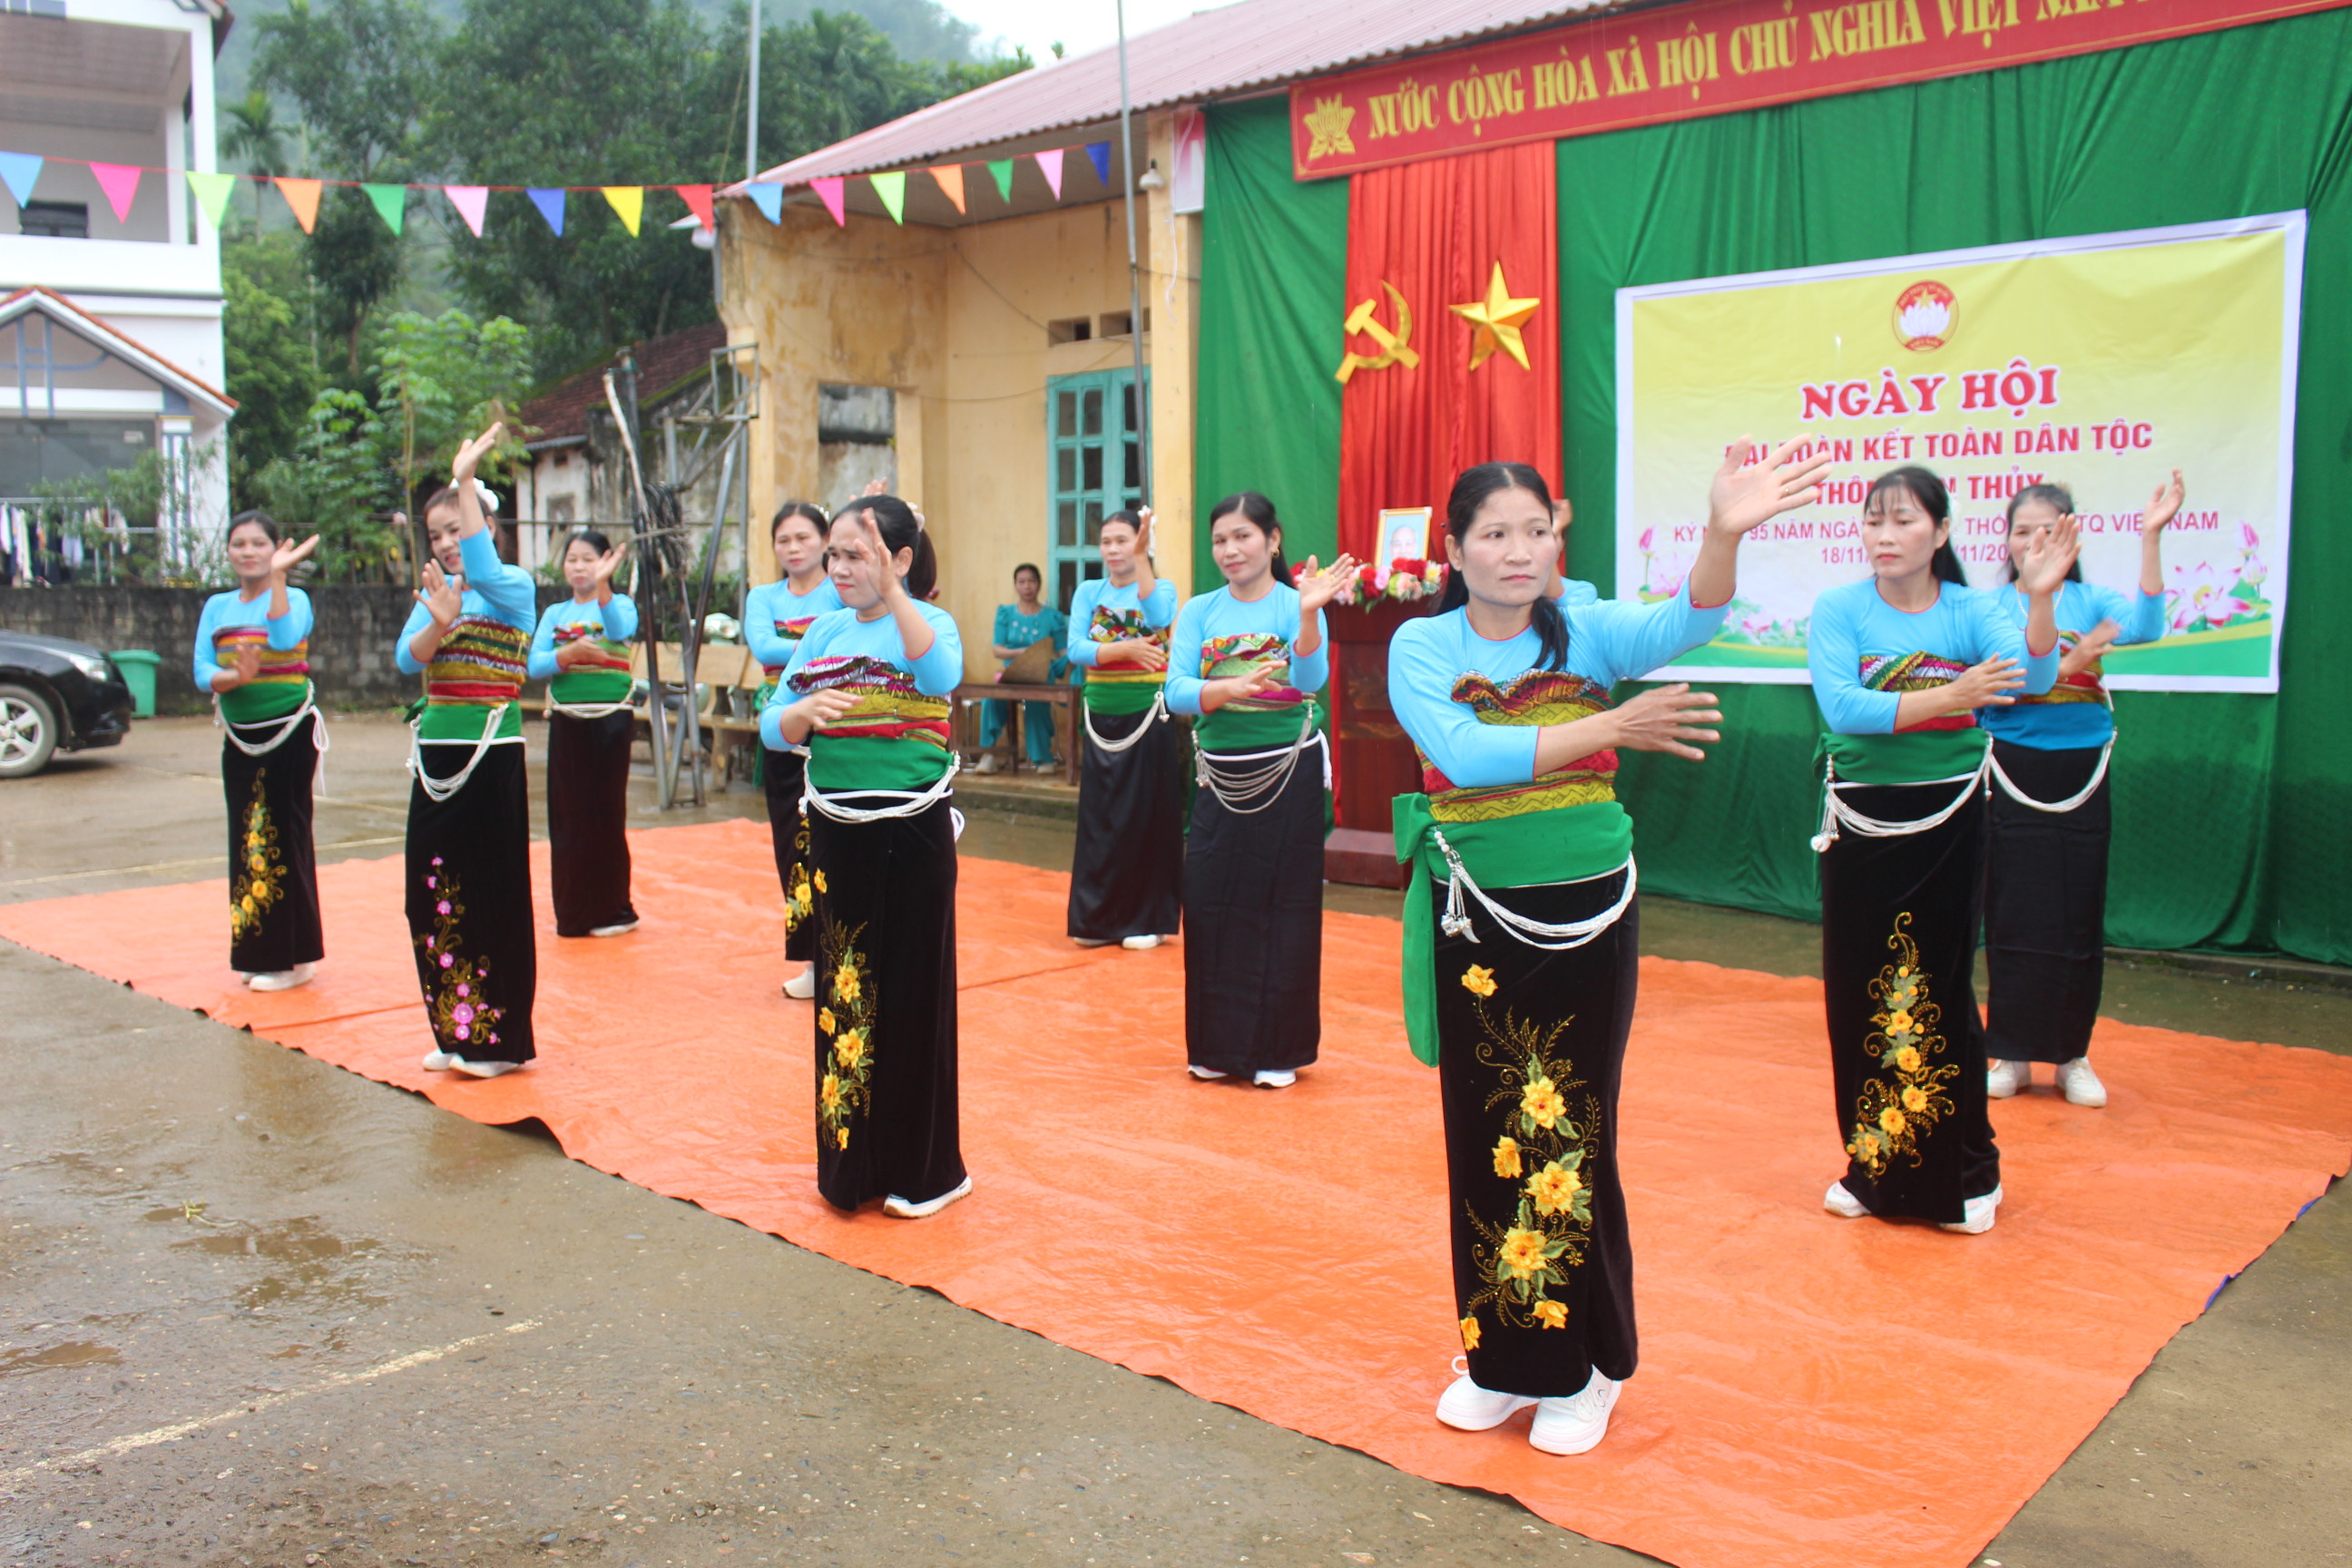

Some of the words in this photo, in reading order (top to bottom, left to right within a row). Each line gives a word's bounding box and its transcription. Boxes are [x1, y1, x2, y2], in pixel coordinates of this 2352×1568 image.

[1367, 75, 1441, 140] NƯỚC
[1447, 63, 1525, 138] CỘNG
[1531, 44, 1601, 110] HÒA
[1656, 19, 1720, 102] HỘI
[1730, 0, 1799, 75] CHỦ
[1801, 368, 1946, 419] NGÀY
[1961, 359, 2058, 416] HỘI
[1864, 427, 1915, 461] KẾT
[1925, 426, 2003, 458] TOÀN
[2014, 422, 2080, 454] DÂN
[2092, 418, 2153, 456] TỘC
[1813, 475, 1870, 505] THÔ
[1774, 517, 1814, 540] NĂM
[1820, 515, 1866, 538] NGÀ
[2112, 510, 2143, 536] VIỆ
[2168, 511, 2219, 531] NAM
